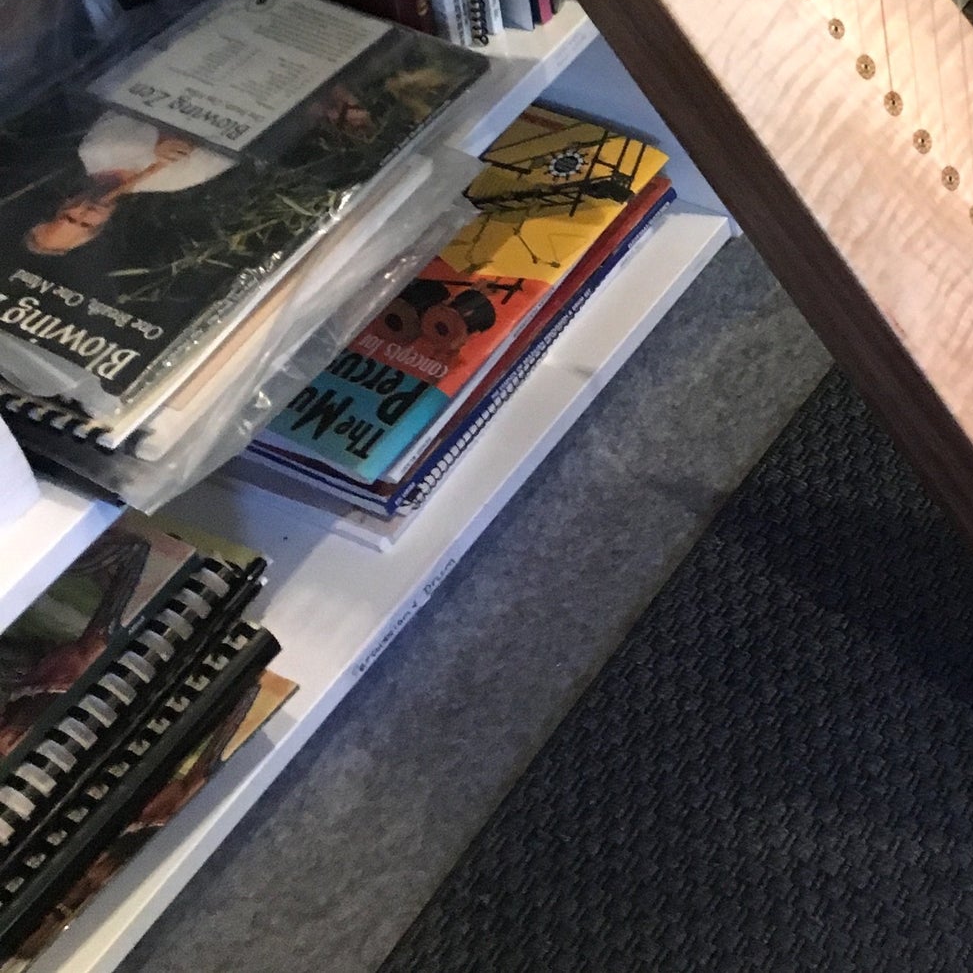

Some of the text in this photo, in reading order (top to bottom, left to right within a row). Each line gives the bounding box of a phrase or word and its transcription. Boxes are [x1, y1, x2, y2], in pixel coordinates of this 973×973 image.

[127, 80, 251, 143] Blowing Zen
[52, 284, 84, 308] One
[0, 296, 141, 382] Blowing
[129, 318, 164, 341] One
[384, 342, 449, 378] Concepts
[323, 348, 430, 426] Percu
[285, 385, 353, 440] Mu
[333, 415, 386, 459] The
[423, 558, 456, 595] Drum
